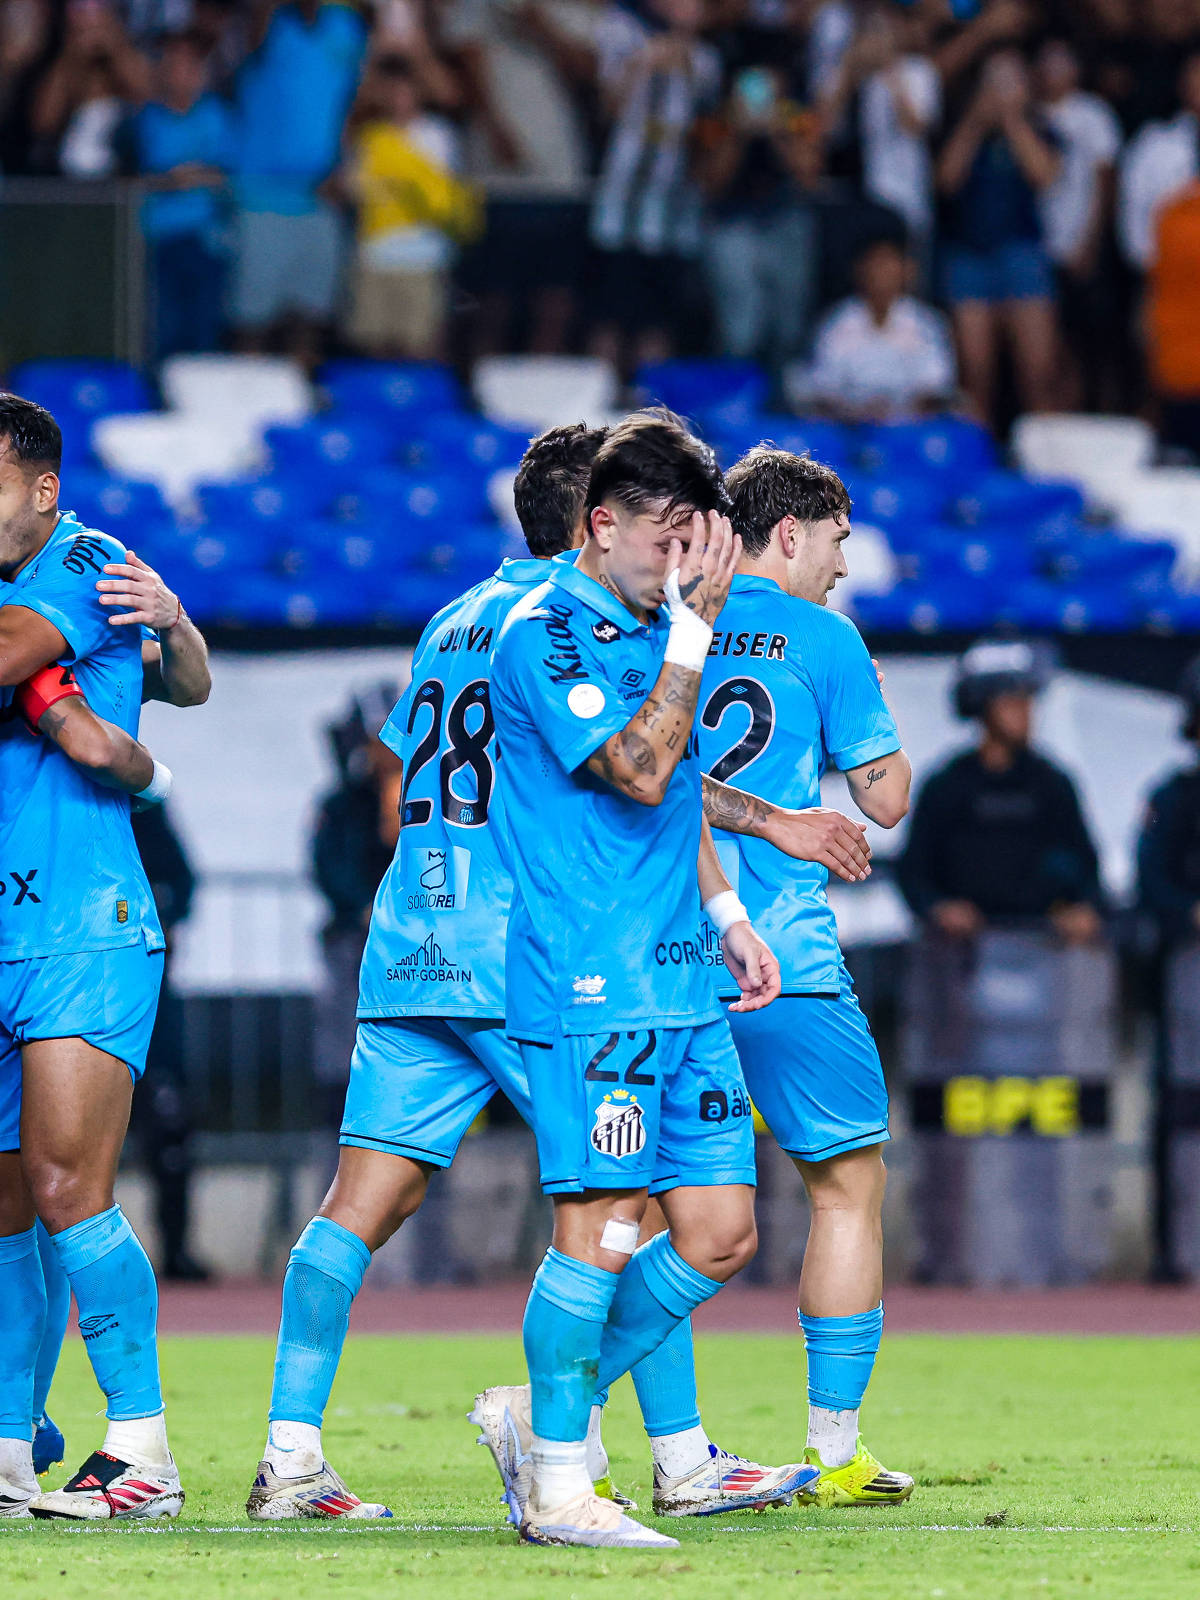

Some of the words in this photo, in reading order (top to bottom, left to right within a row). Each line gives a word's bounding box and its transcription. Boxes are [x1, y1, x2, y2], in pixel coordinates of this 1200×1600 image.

[438, 624, 495, 654] OLIVA
[400, 678, 497, 830] 28
[864, 768, 888, 790] Juan
[407, 891, 456, 910] SÓCIOREI
[386, 968, 472, 983] SAINT-GOBAIN
[584, 1029, 655, 1086] 22
